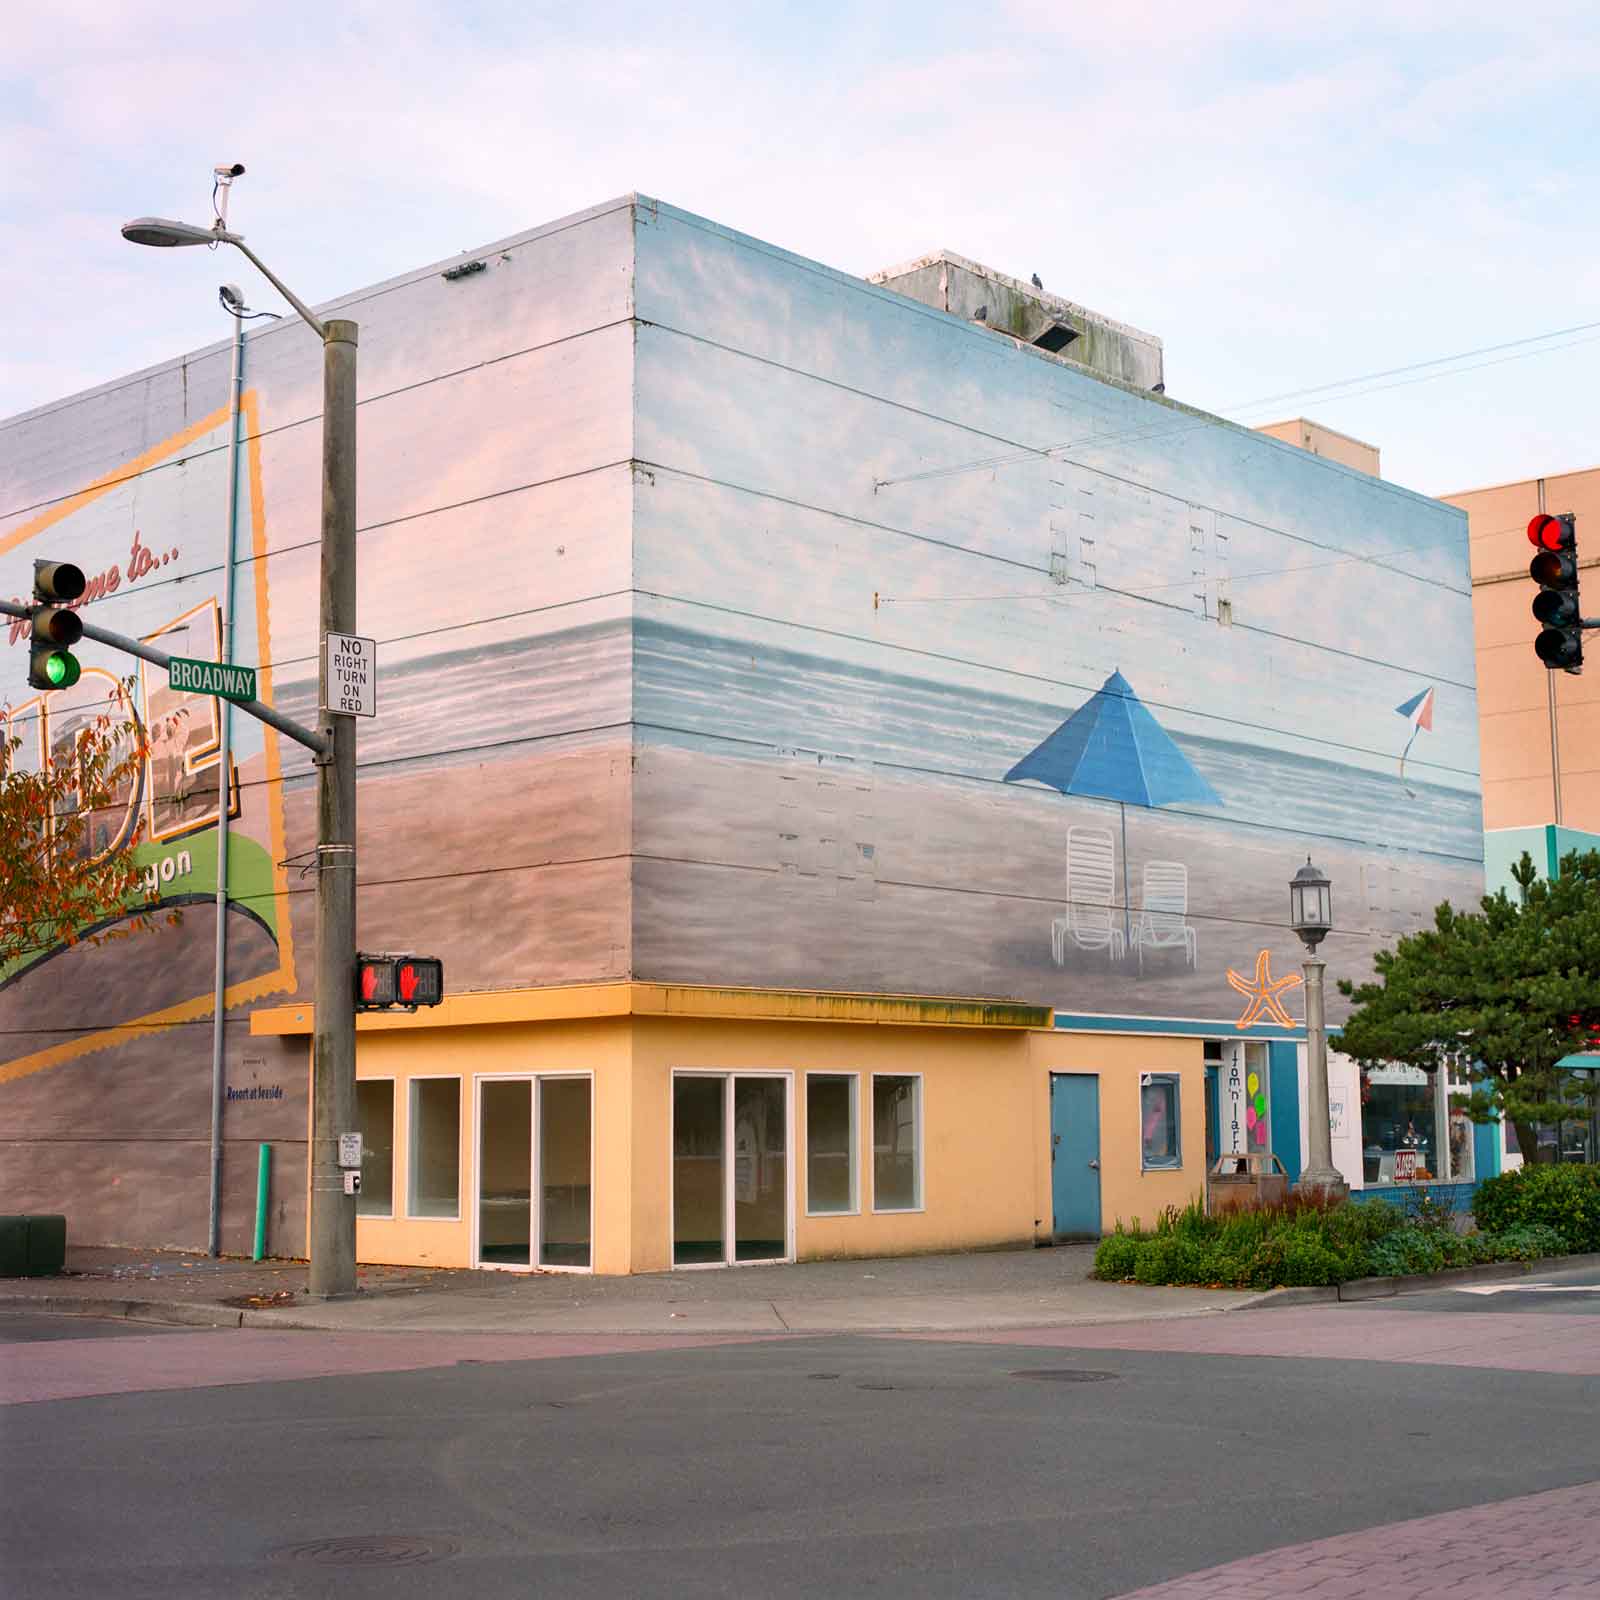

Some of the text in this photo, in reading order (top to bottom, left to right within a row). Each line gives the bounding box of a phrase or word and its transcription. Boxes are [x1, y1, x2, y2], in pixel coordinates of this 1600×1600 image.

[340, 638, 362, 655] NO
[334, 654, 368, 670] RIGHT
[170, 663, 254, 696] BROADWAY
[336, 669, 367, 684] TURN
[343, 684, 360, 697] ON
[340, 697, 362, 711] RED
